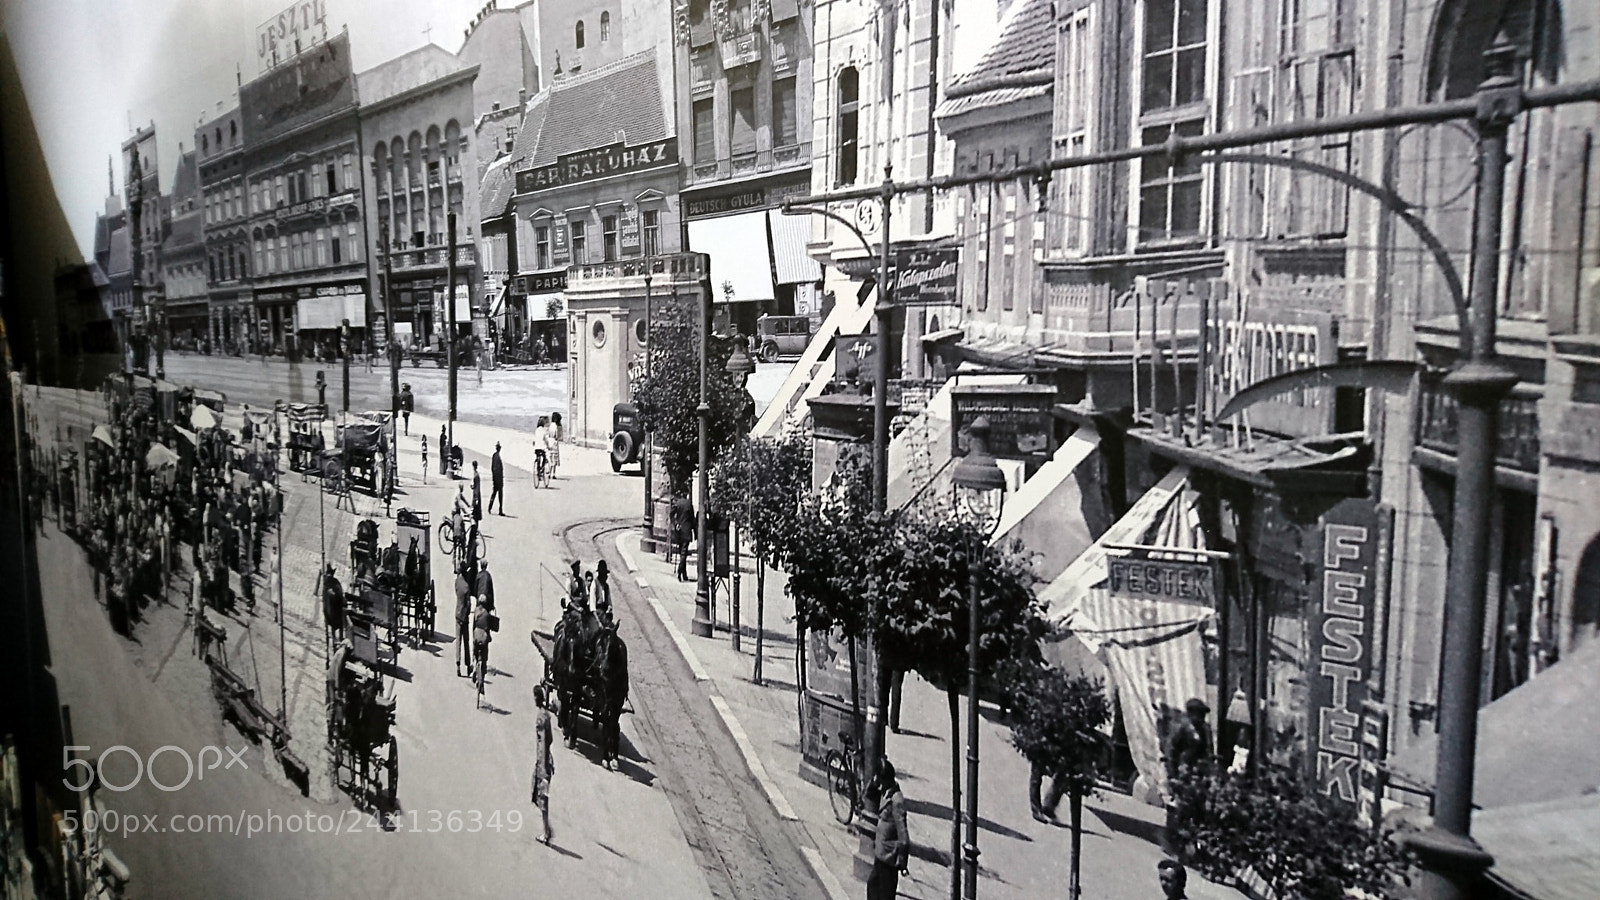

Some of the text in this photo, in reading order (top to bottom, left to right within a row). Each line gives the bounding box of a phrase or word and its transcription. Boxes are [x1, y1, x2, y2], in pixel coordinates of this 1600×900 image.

[690, 193, 763, 214] DEUTSCH GYULA
[1111, 561, 1209, 599] FESTEK
[1316, 523, 1369, 803] FESTEK
